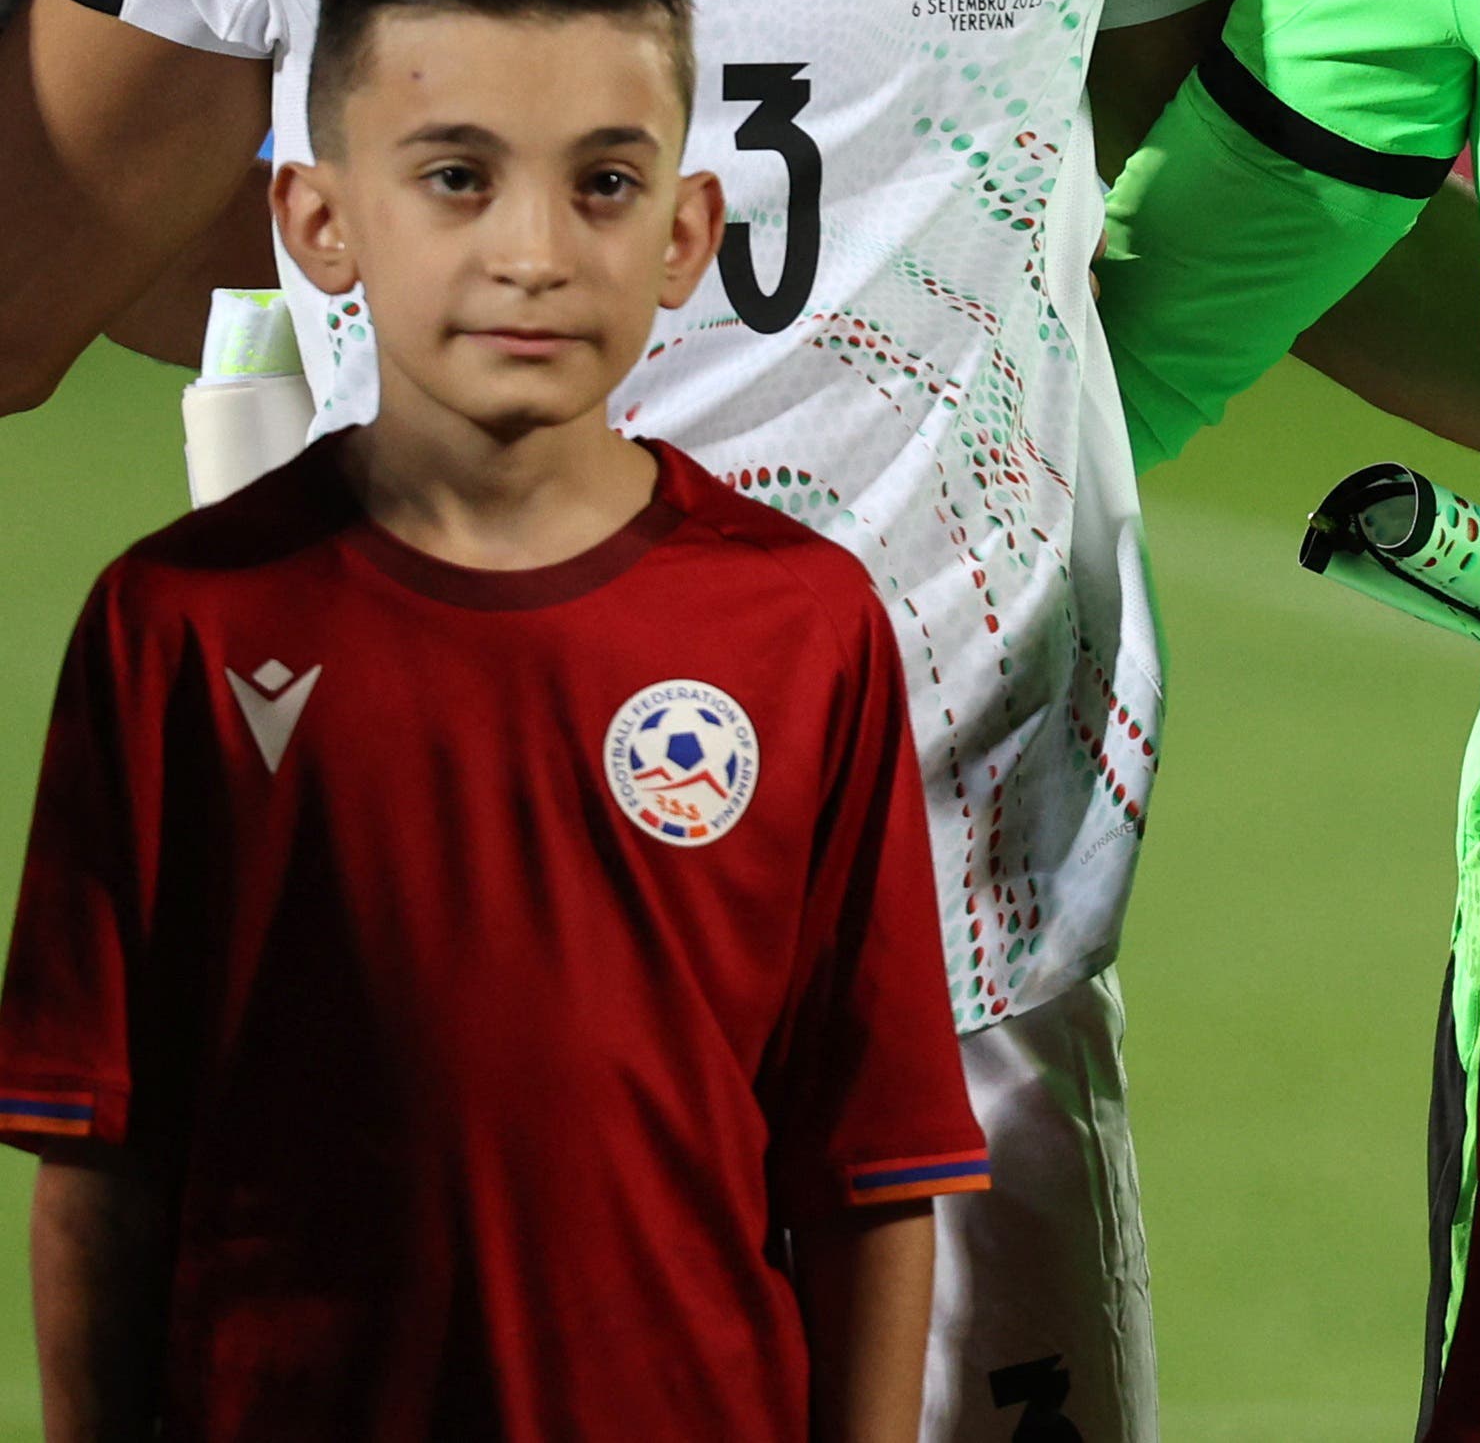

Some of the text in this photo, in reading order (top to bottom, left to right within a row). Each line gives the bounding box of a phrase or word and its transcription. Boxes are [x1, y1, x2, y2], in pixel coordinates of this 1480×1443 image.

[911, 1, 921, 17] 6
[949, 12, 1015, 31] YEREVAN
[717, 63, 822, 334] 3
[611, 686, 753, 830] FOOTBALL FEDERATION OF ARMENIA
